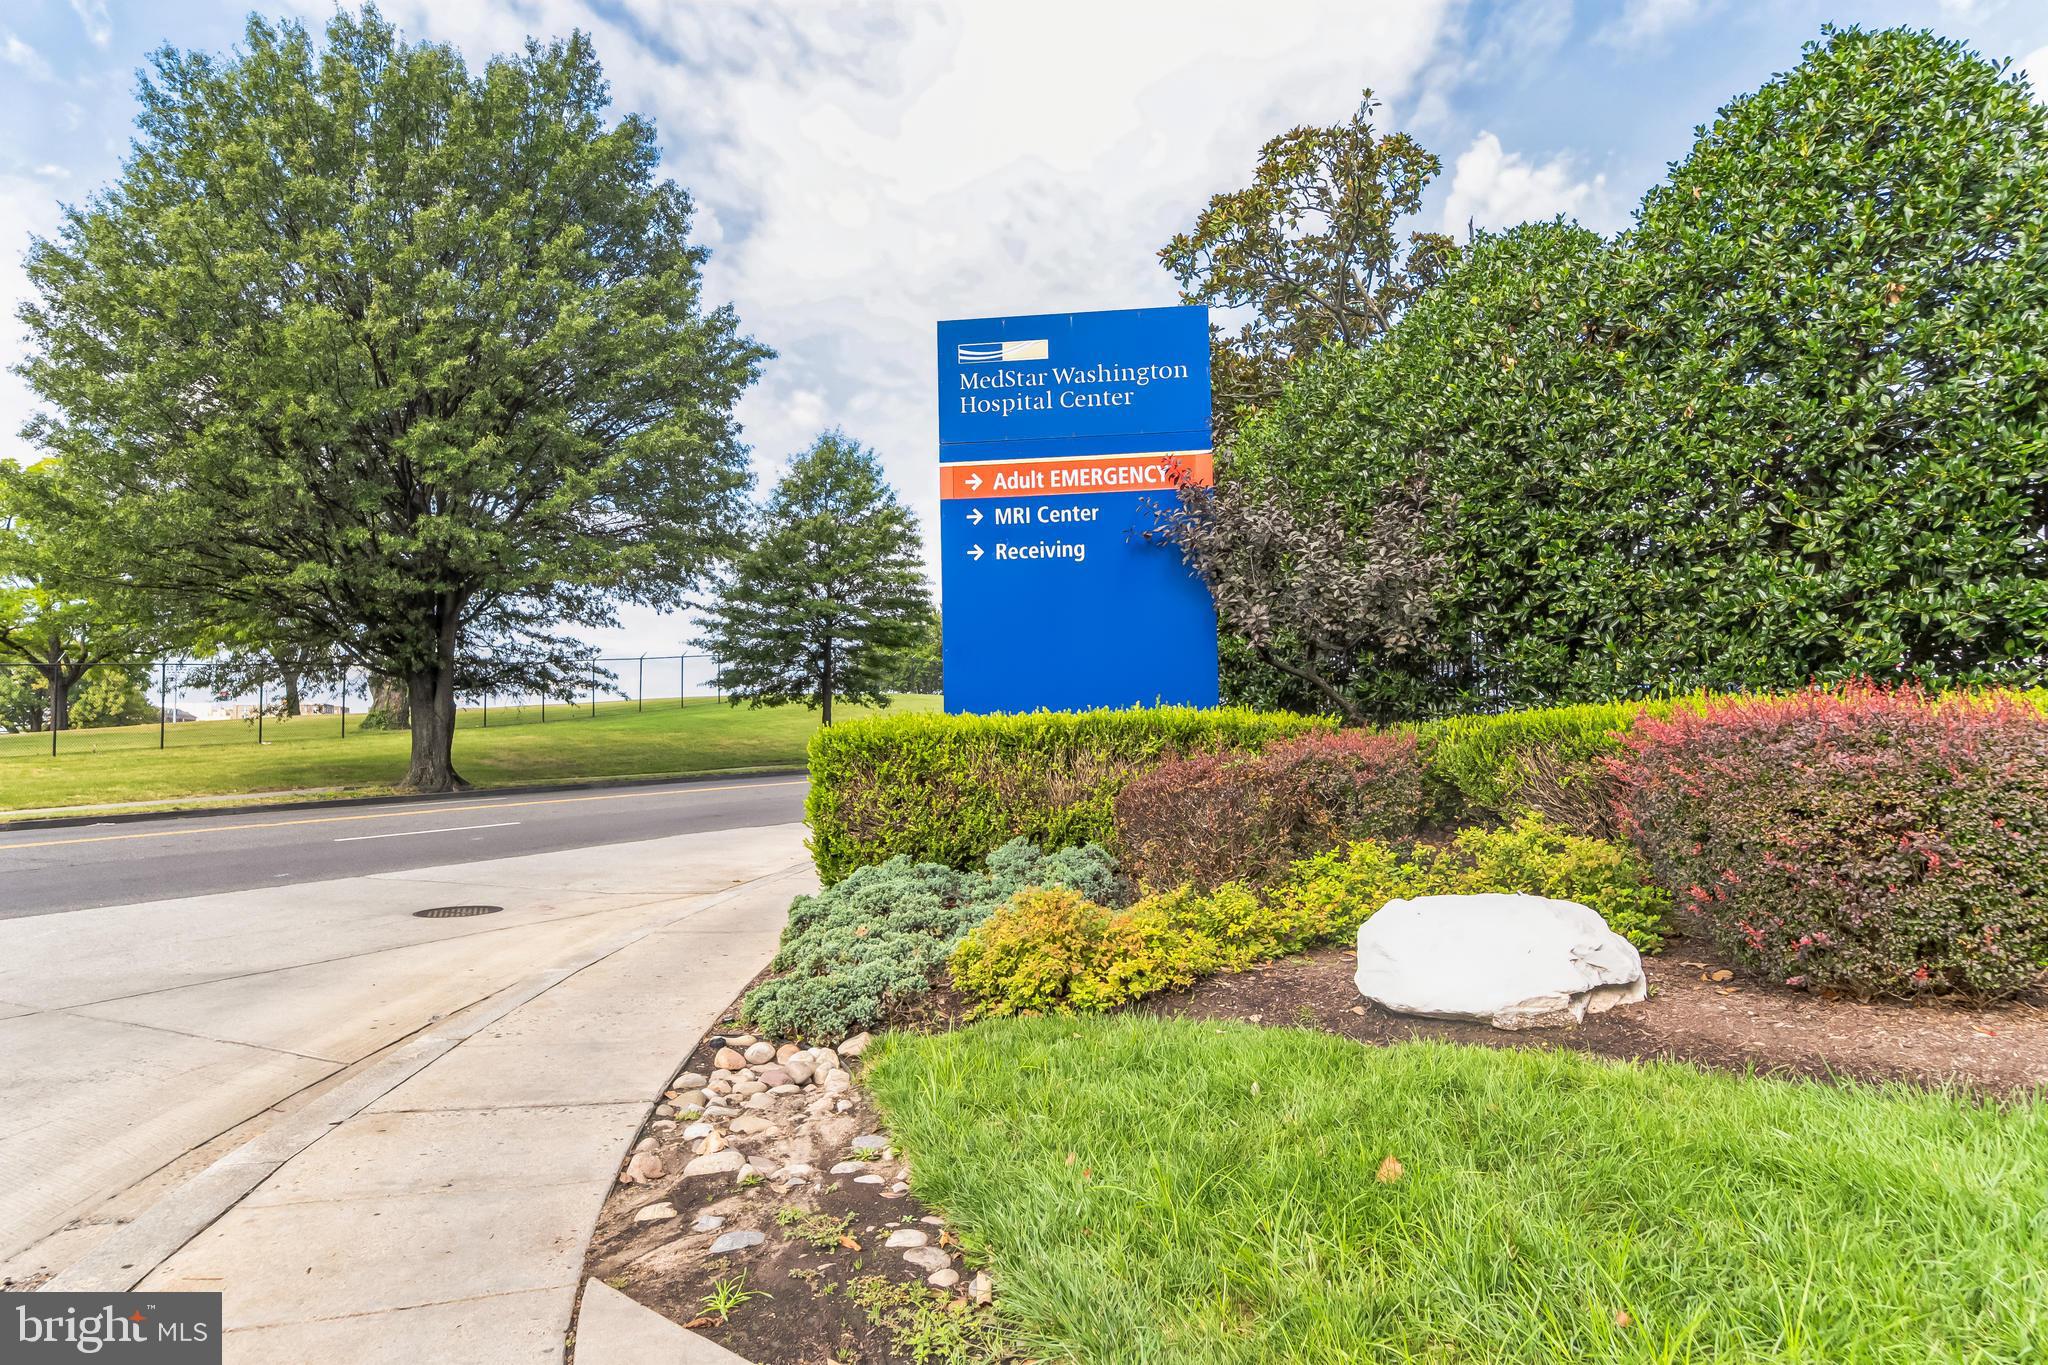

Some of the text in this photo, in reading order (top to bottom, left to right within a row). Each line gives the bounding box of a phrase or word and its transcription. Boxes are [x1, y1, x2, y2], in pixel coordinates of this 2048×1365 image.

[960, 362, 1189, 390] MedStar Washington
[960, 389, 1135, 417] Hospital Center
[993, 465, 1170, 490] Adult EMERGENCY
[995, 505, 1099, 525] MRI Center
[995, 540, 1086, 562] Receiving
